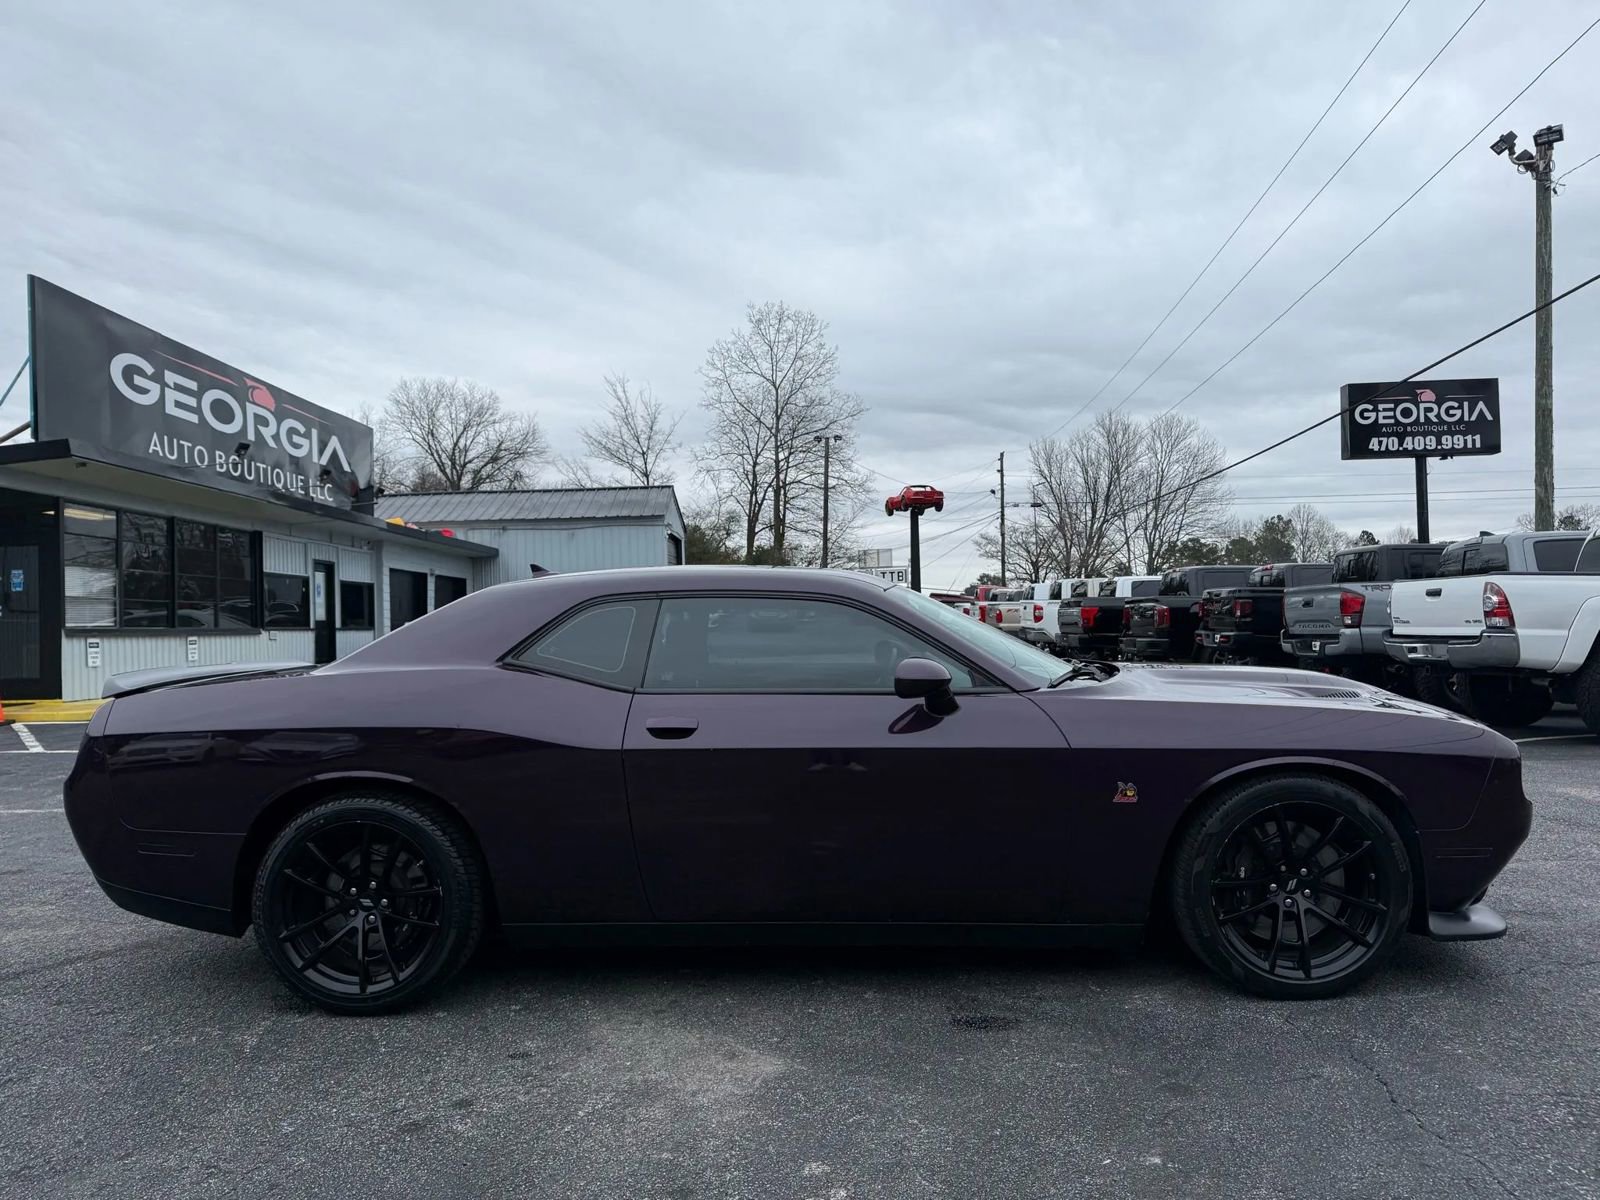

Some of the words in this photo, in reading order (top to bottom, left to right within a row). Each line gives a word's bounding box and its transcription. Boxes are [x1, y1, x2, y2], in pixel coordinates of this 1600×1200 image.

[109, 352, 351, 472] GEORGIA
[1354, 400, 1493, 425] GEORGIA
[1406, 424, 1448, 432] BOUTIQUE
[1368, 434, 1481, 451] 470.409.9911
[149, 432, 208, 468] AUTO
[215, 450, 305, 493] BOUTIQUE
[309, 478, 334, 501] LLC
